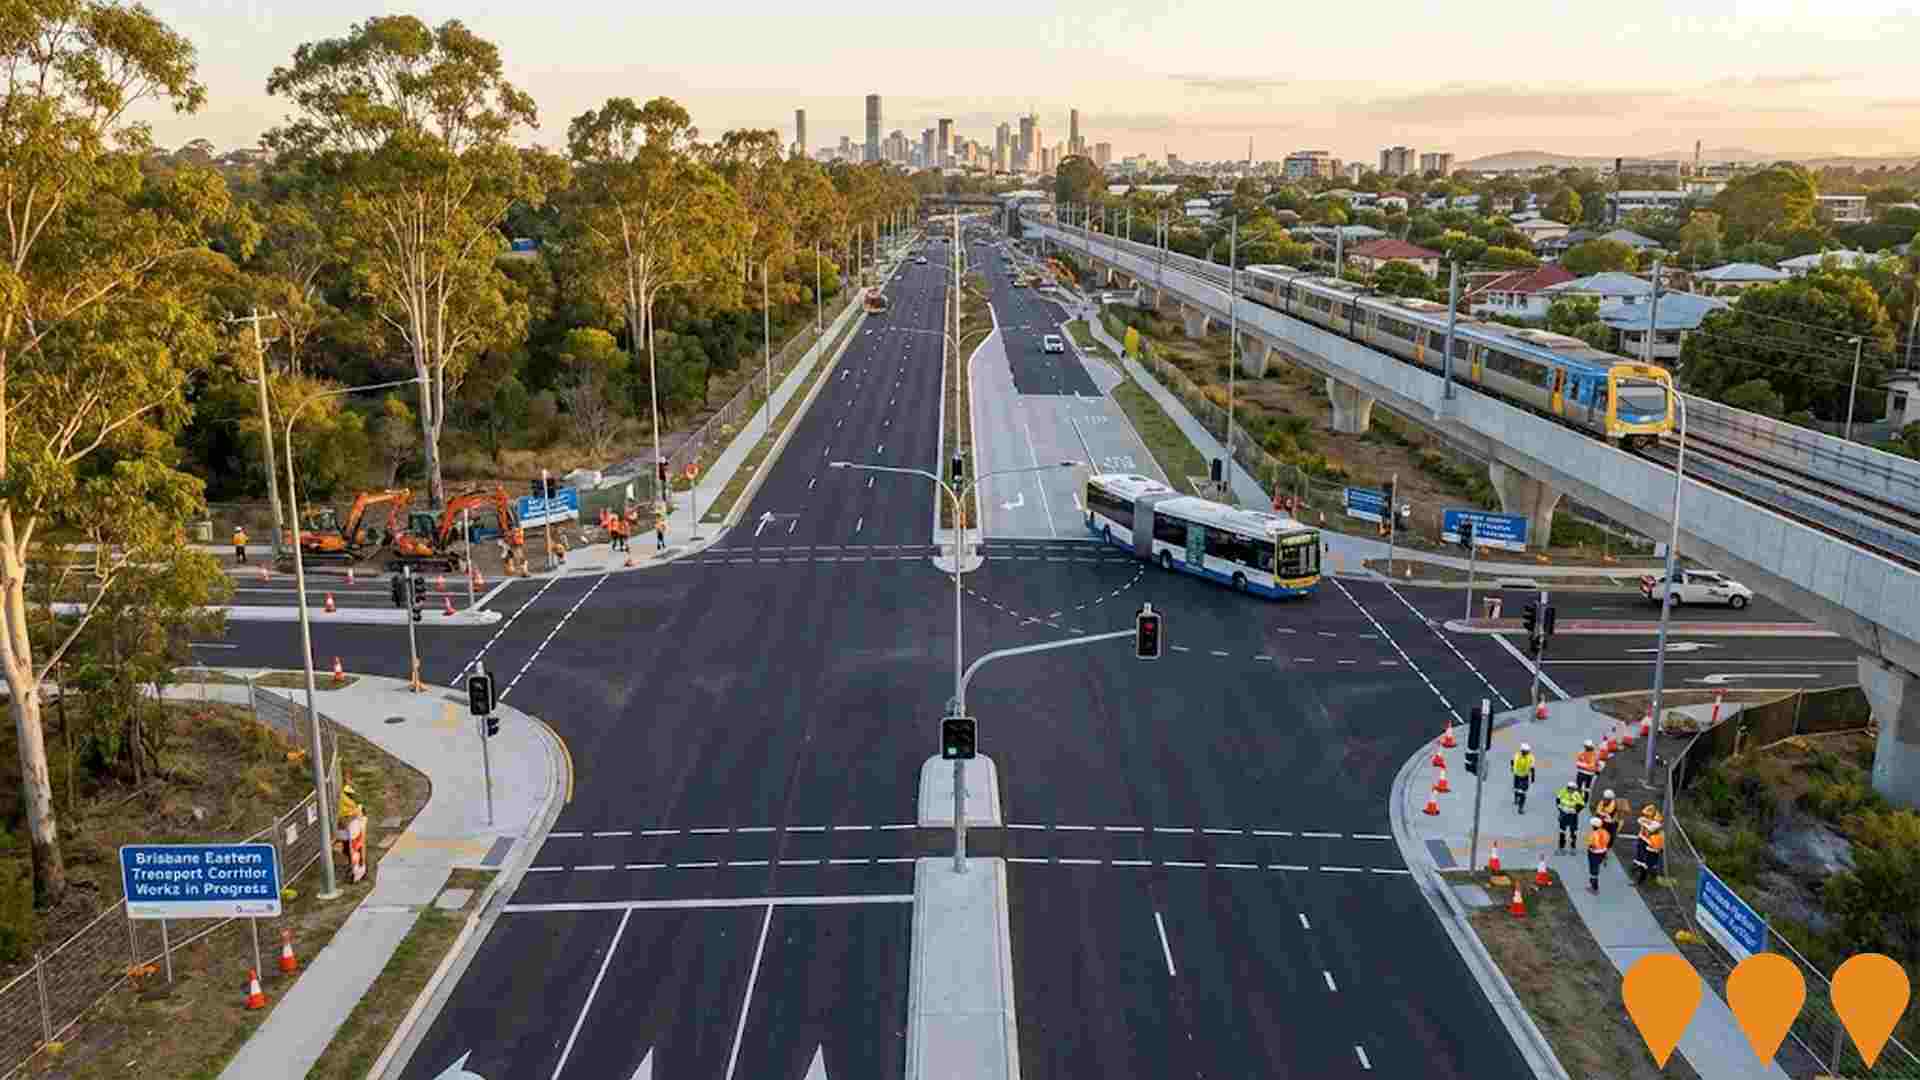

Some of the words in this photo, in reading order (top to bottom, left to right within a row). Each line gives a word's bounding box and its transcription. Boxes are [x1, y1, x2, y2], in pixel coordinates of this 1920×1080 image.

[136, 853, 200, 864] Brisbane
[205, 852, 262, 864] Eastern
[185, 884, 199, 894] in
[205, 884, 268, 897] Progress
